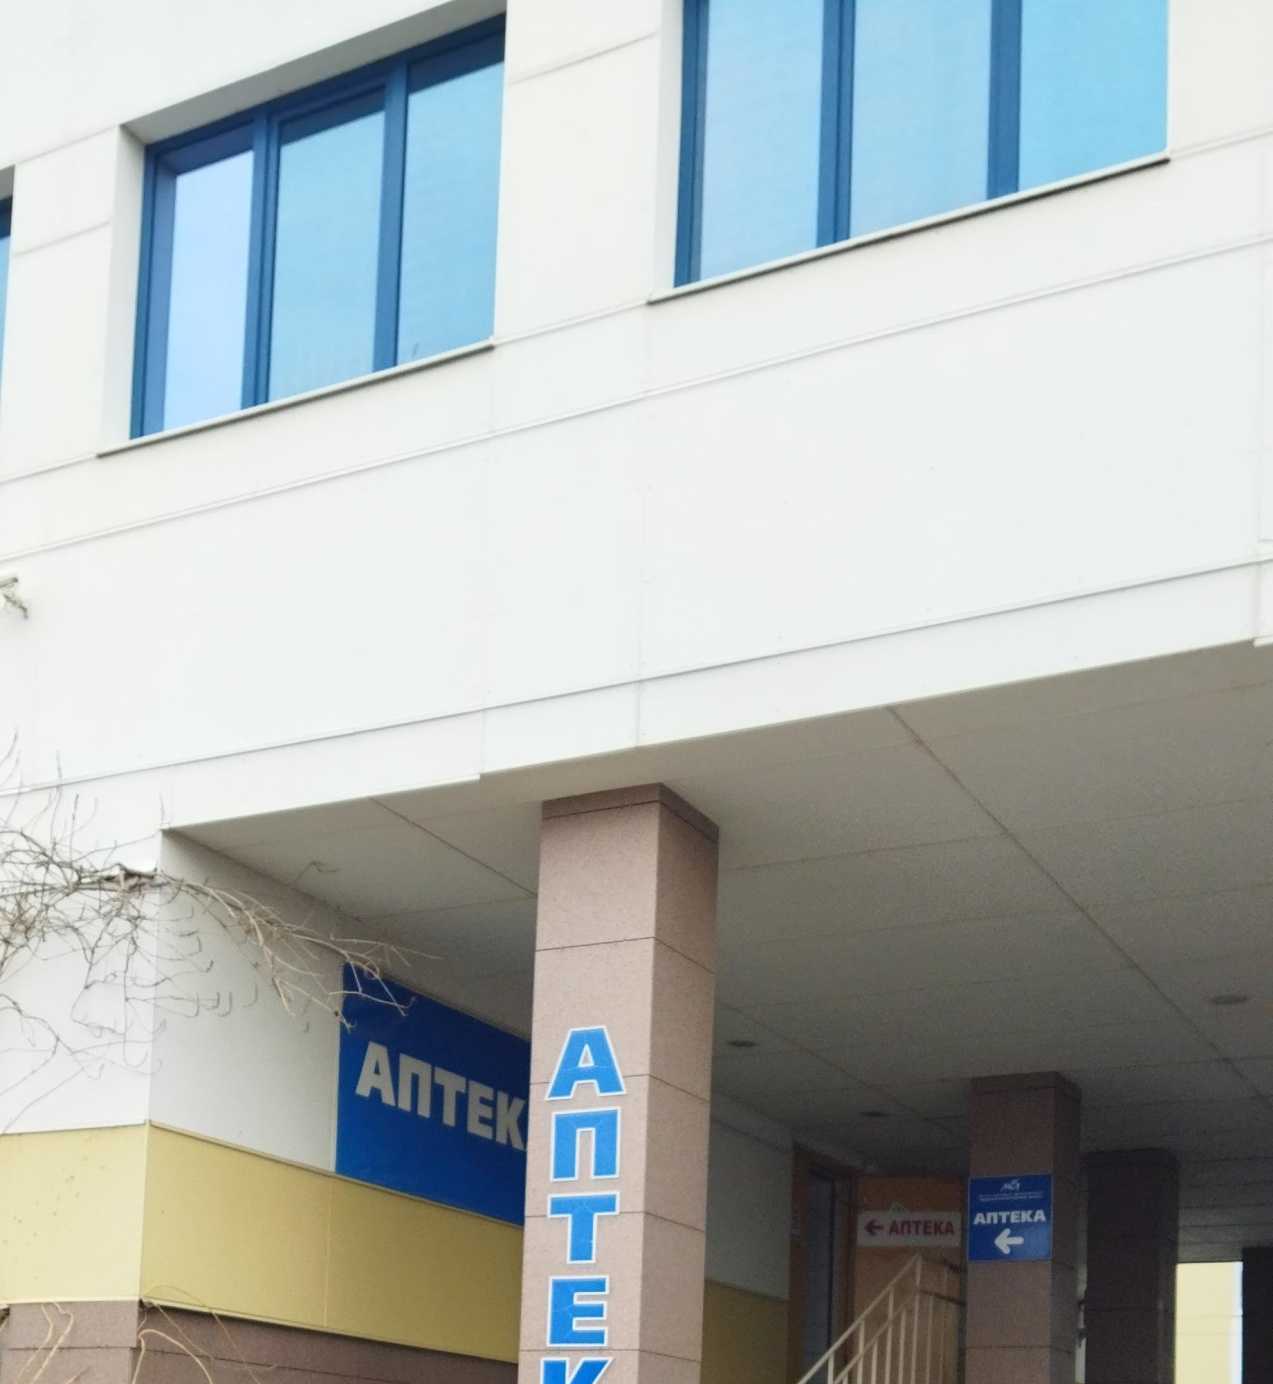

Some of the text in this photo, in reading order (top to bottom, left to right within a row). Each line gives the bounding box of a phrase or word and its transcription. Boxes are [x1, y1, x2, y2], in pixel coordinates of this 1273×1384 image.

[355, 1040, 528, 1151] АПТЕК
[973, 1208, 1046, 1225] АПТЕКА
[888, 1219, 955, 1236] АПТЕКА
